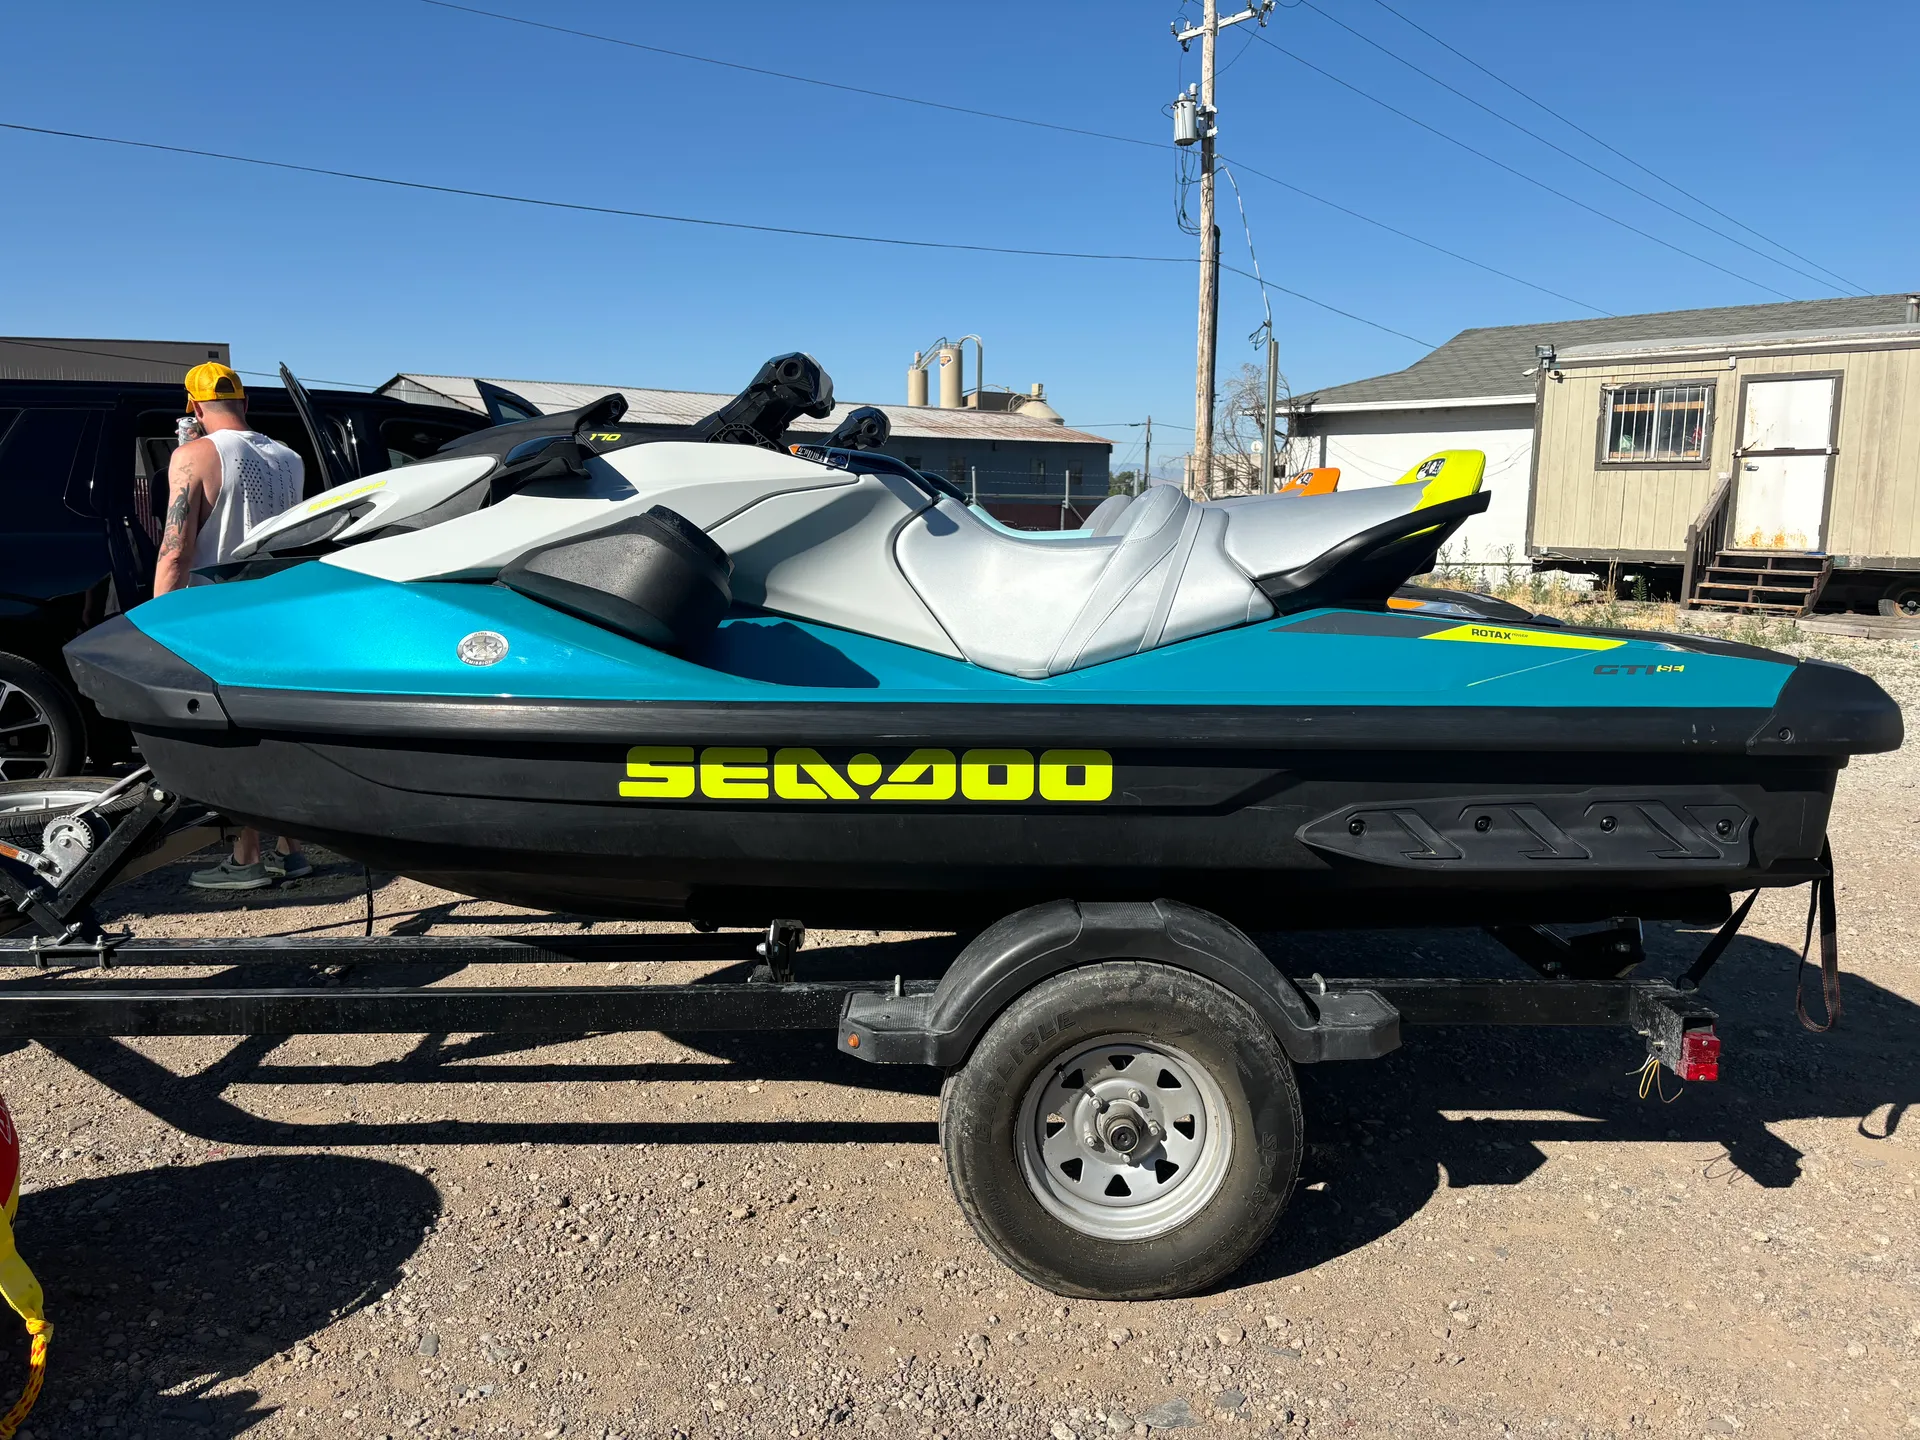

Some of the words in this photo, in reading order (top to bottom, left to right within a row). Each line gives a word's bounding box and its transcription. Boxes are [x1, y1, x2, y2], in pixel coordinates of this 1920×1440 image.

[589, 433, 622, 441] 170
[1471, 628, 1512, 640] ROTAX
[1593, 664, 1656, 675] GTI
[1656, 664, 1685, 672] SE
[974, 1009, 1077, 1145] CARLISLE
[1245, 1131, 1279, 1220] SPORT
